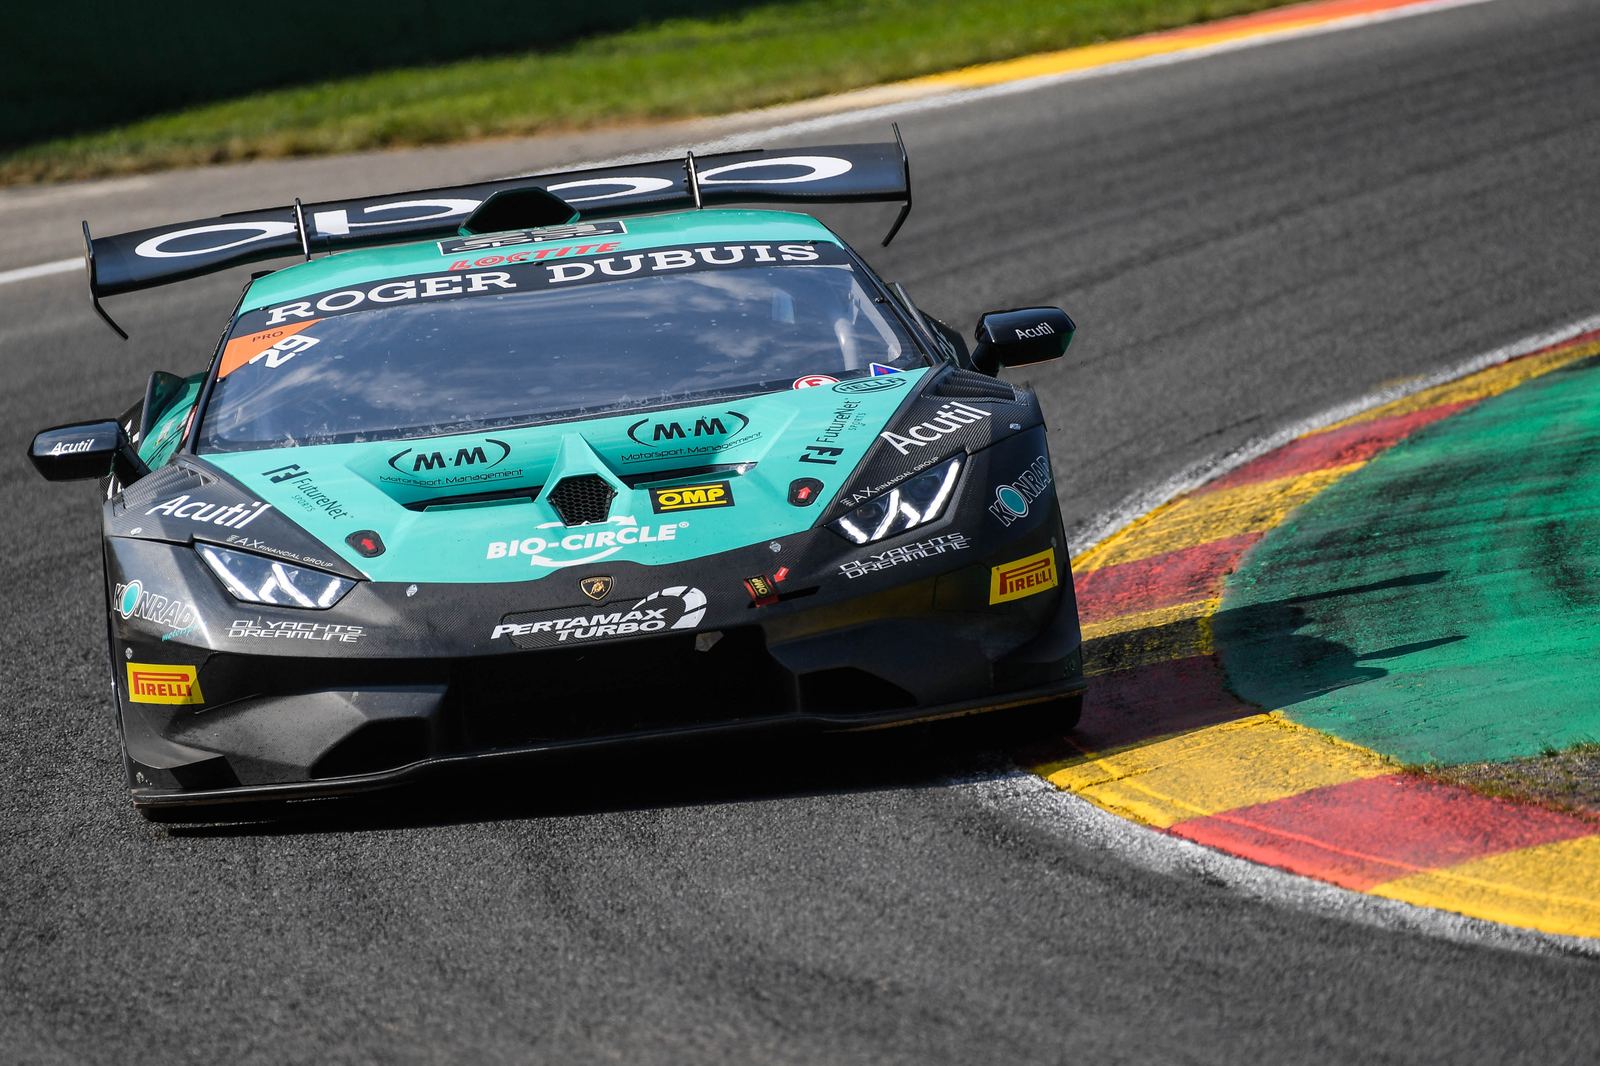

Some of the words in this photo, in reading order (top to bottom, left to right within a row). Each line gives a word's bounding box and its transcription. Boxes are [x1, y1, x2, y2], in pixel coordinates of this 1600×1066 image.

[448, 242, 621, 271] LOCTITE
[265, 271, 517, 326] ROGER
[546, 244, 820, 284] DUBUIS
[252, 330, 284, 342] PRO
[1014, 322, 1056, 341] Acutil
[248, 334, 321, 369] 29
[840, 377, 901, 392] HELLA
[815, 399, 861, 443] FutureNet
[879, 401, 992, 456] Acutil
[50, 438, 95, 455] Acutil
[621, 448, 683, 462] Motorsport
[687, 431, 762, 454] Management
[379, 475, 442, 487] Motorsport
[445, 468, 524, 484] Management
[875, 471, 914, 492] FINANCIAL
[913, 456, 939, 472] GROUP
[291, 477, 348, 520] FutureNet
[658, 488, 725, 506] OMP
[145, 494, 272, 529] Acutil
[258, 545, 300, 560] FINANCIAL
[302, 556, 334, 568] GROUP
[845, 541, 970, 579] DREAMLINE
[870, 532, 965, 560] YACHTS
[751, 578, 768, 595] OMP
[999, 557, 1052, 596] PIRELLI
[113, 579, 197, 630] KONRAD
[228, 629, 358, 643] DREAMLINE
[266, 621, 364, 634] YACHTS
[490, 608, 668, 639] PERTAMAX
[555, 620, 666, 641] TURBO
[132, 671, 192, 697] PIRELLI
